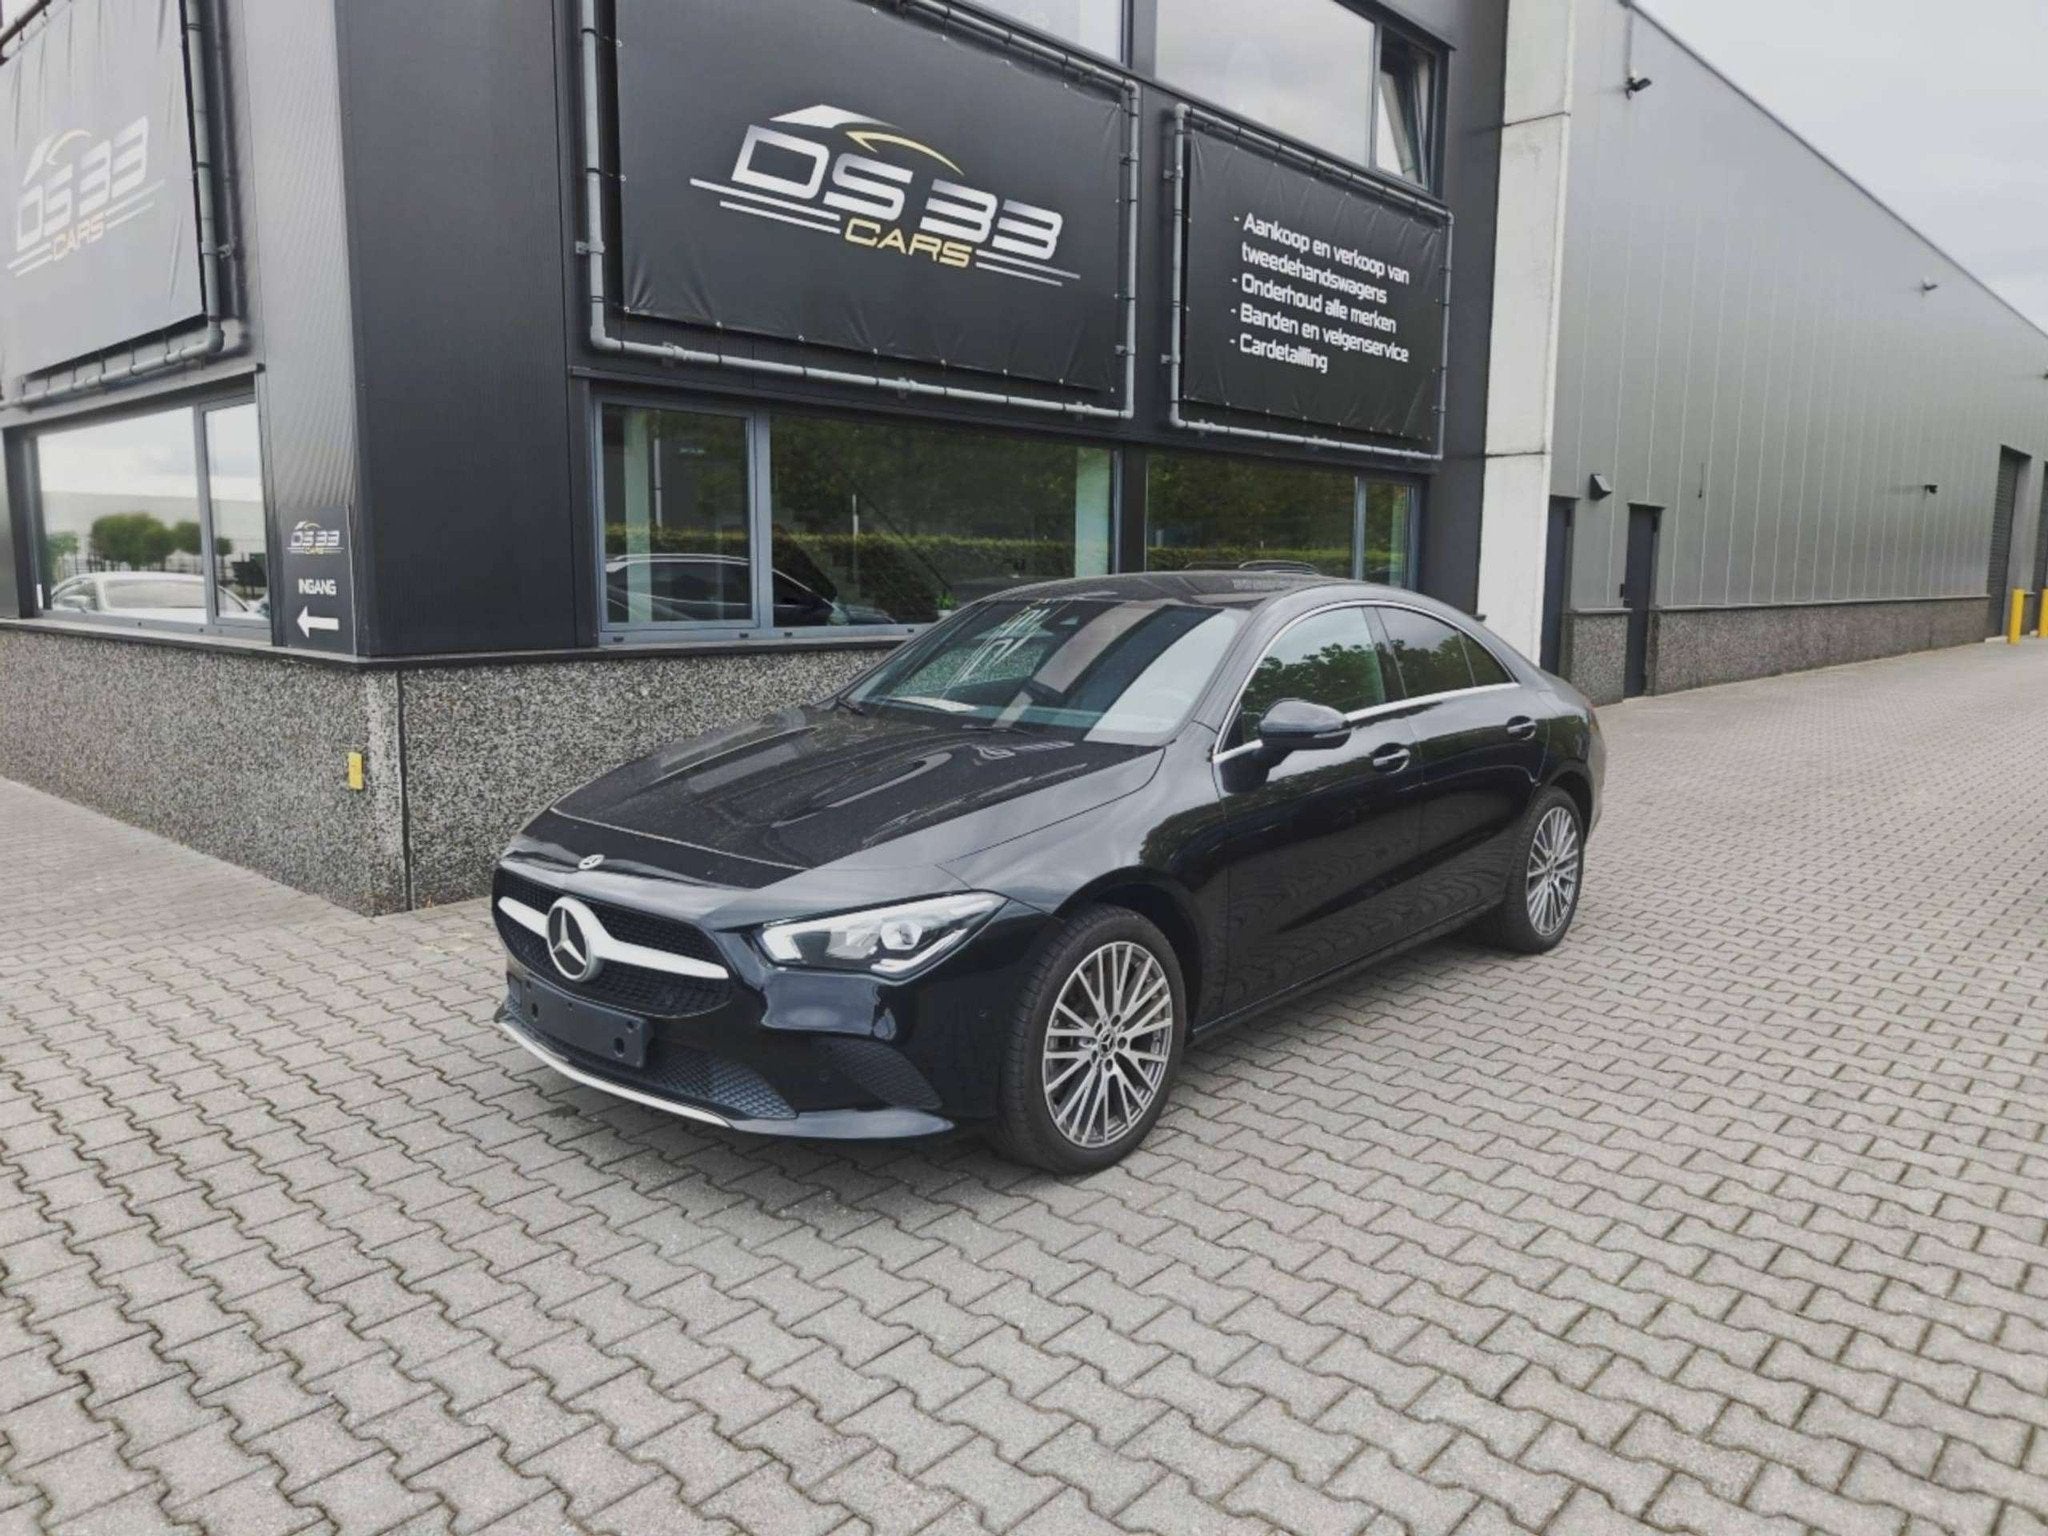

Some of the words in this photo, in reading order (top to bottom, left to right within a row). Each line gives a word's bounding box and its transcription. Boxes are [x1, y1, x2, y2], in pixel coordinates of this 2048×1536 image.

[731, 124, 913, 221] DS
[919, 178, 1063, 260] 33
[52, 212, 105, 262] CARS
[845, 217, 973, 268] CARS
[1243, 211, 1311, 254] Aankoop
[1312, 239, 1331, 259] en
[1333, 246, 1386, 280] verkoop
[1386, 264, 1410, 285] van
[1241, 240, 1388, 304] tweedehandswagens
[1240, 302, 1299, 335] Banden
[1301, 322, 1320, 340] en
[1322, 327, 1409, 362] velgenservice
[1241, 272, 1323, 313] Onderhoud
[1325, 298, 1348, 320] alle
[1350, 307, 1397, 334] merken
[298, 578, 337, 595] INGANG
